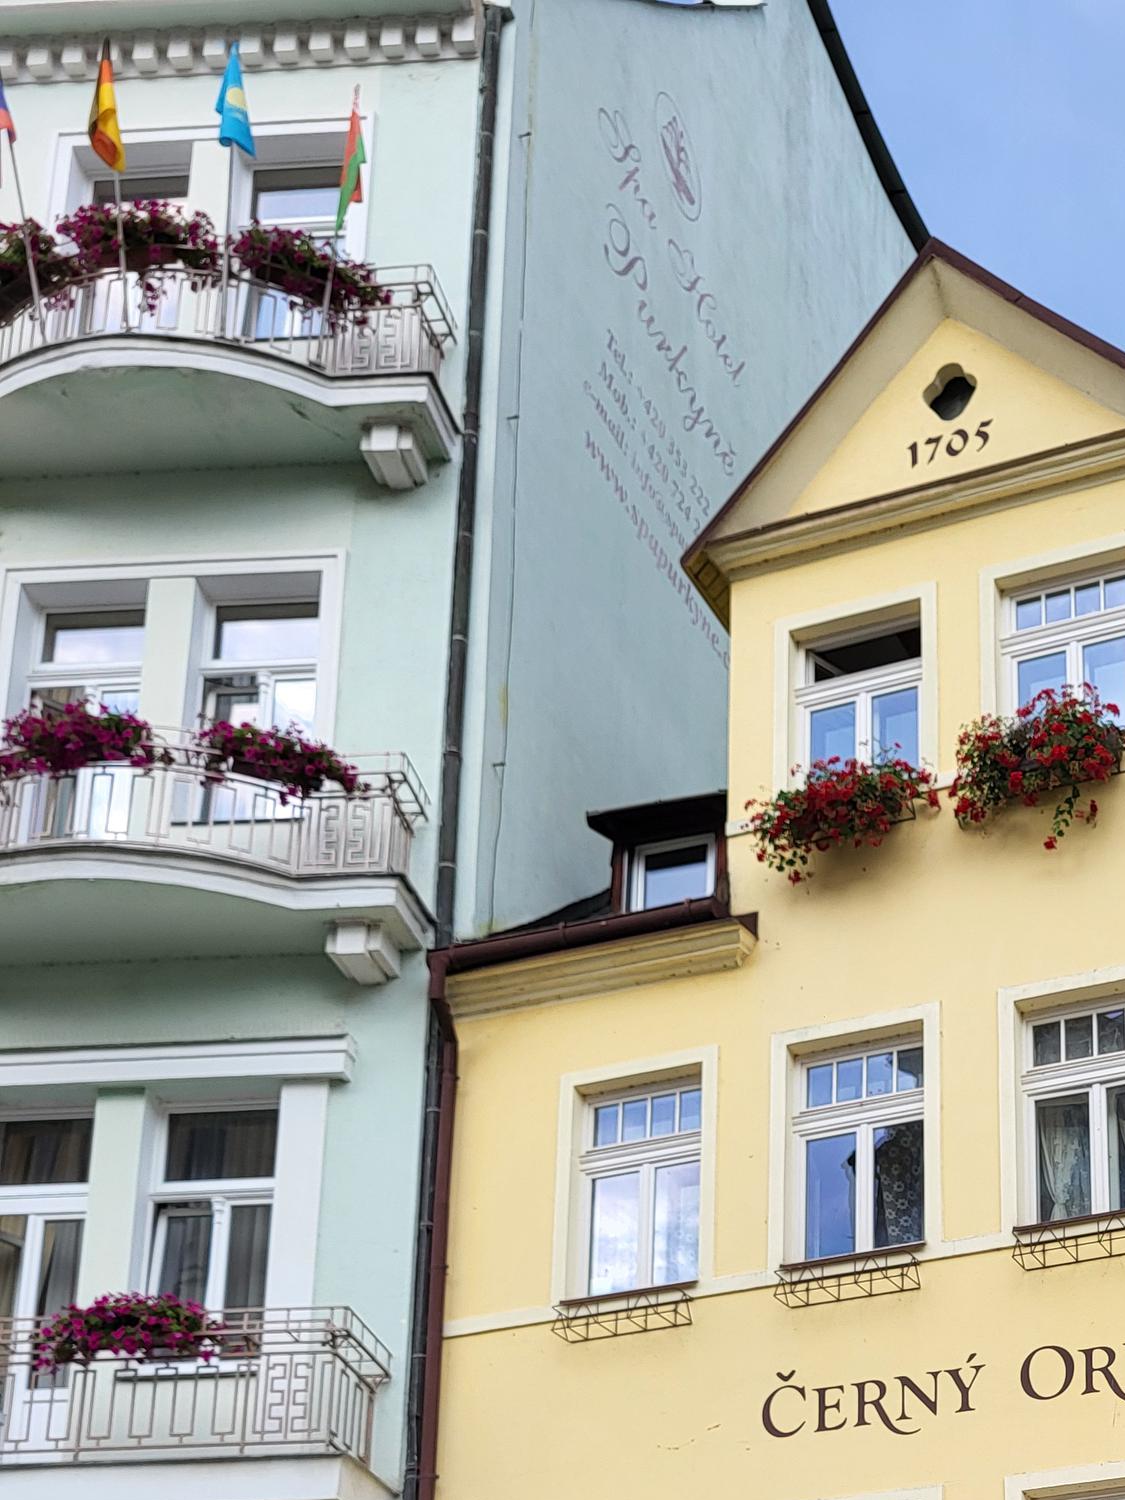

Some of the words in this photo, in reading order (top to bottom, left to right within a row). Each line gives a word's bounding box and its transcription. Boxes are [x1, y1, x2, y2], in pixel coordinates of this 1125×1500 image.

[599, 107, 656, 229] Spa
[667, 238, 745, 387] Hotel
[906, 419, 993, 468] 1705
[631, 451, 689, 551] info@spa
[690, 474, 710, 517] 222
[761, 1353, 986, 1438] ČERNÝ
